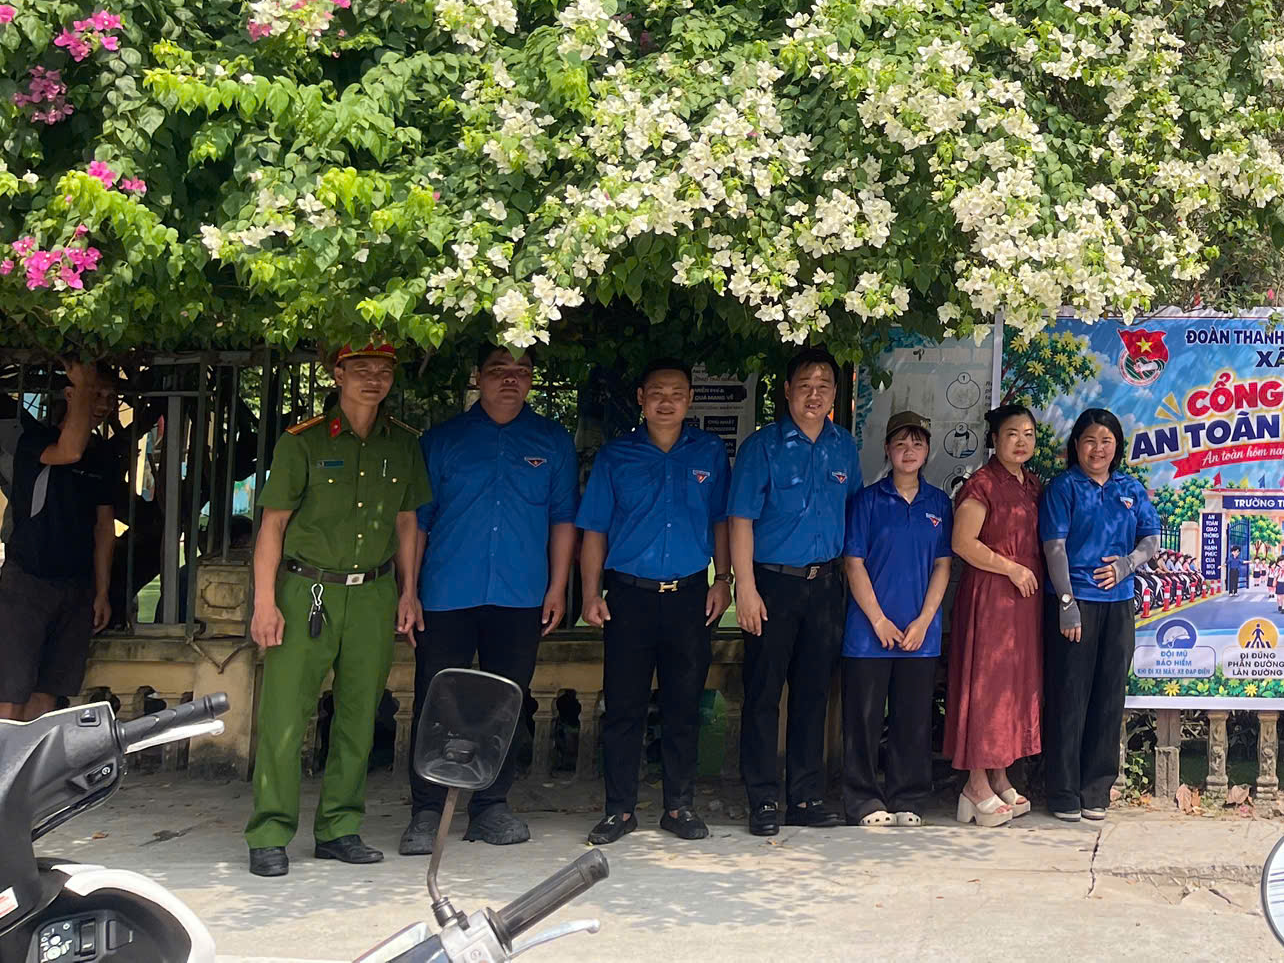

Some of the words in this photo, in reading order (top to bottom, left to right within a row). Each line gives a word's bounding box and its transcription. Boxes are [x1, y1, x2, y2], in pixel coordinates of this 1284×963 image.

[1186, 327, 1229, 345] ĐOÀN
[1234, 330, 1284, 345] THANH
[1187, 372, 1284, 417] CỔNG
[1131, 427, 1179, 461] AN
[1184, 411, 1280, 449] TOÀN
[1202, 451, 1219, 466] An
[1221, 448, 1244, 461] toàn
[1247, 445, 1267, 459] hôm
[1234, 496, 1275, 508] TRƯỜNG
[1160, 650, 1175, 659] ĐỘI
[1176, 649, 1188, 657] MŨ
[1251, 651, 1276, 659] ĐÚNG
[1174, 657, 1192, 666] HIỂM
[1232, 667, 1249, 676] LÀN
[1251, 667, 1283, 676] ĐƯỜNG
